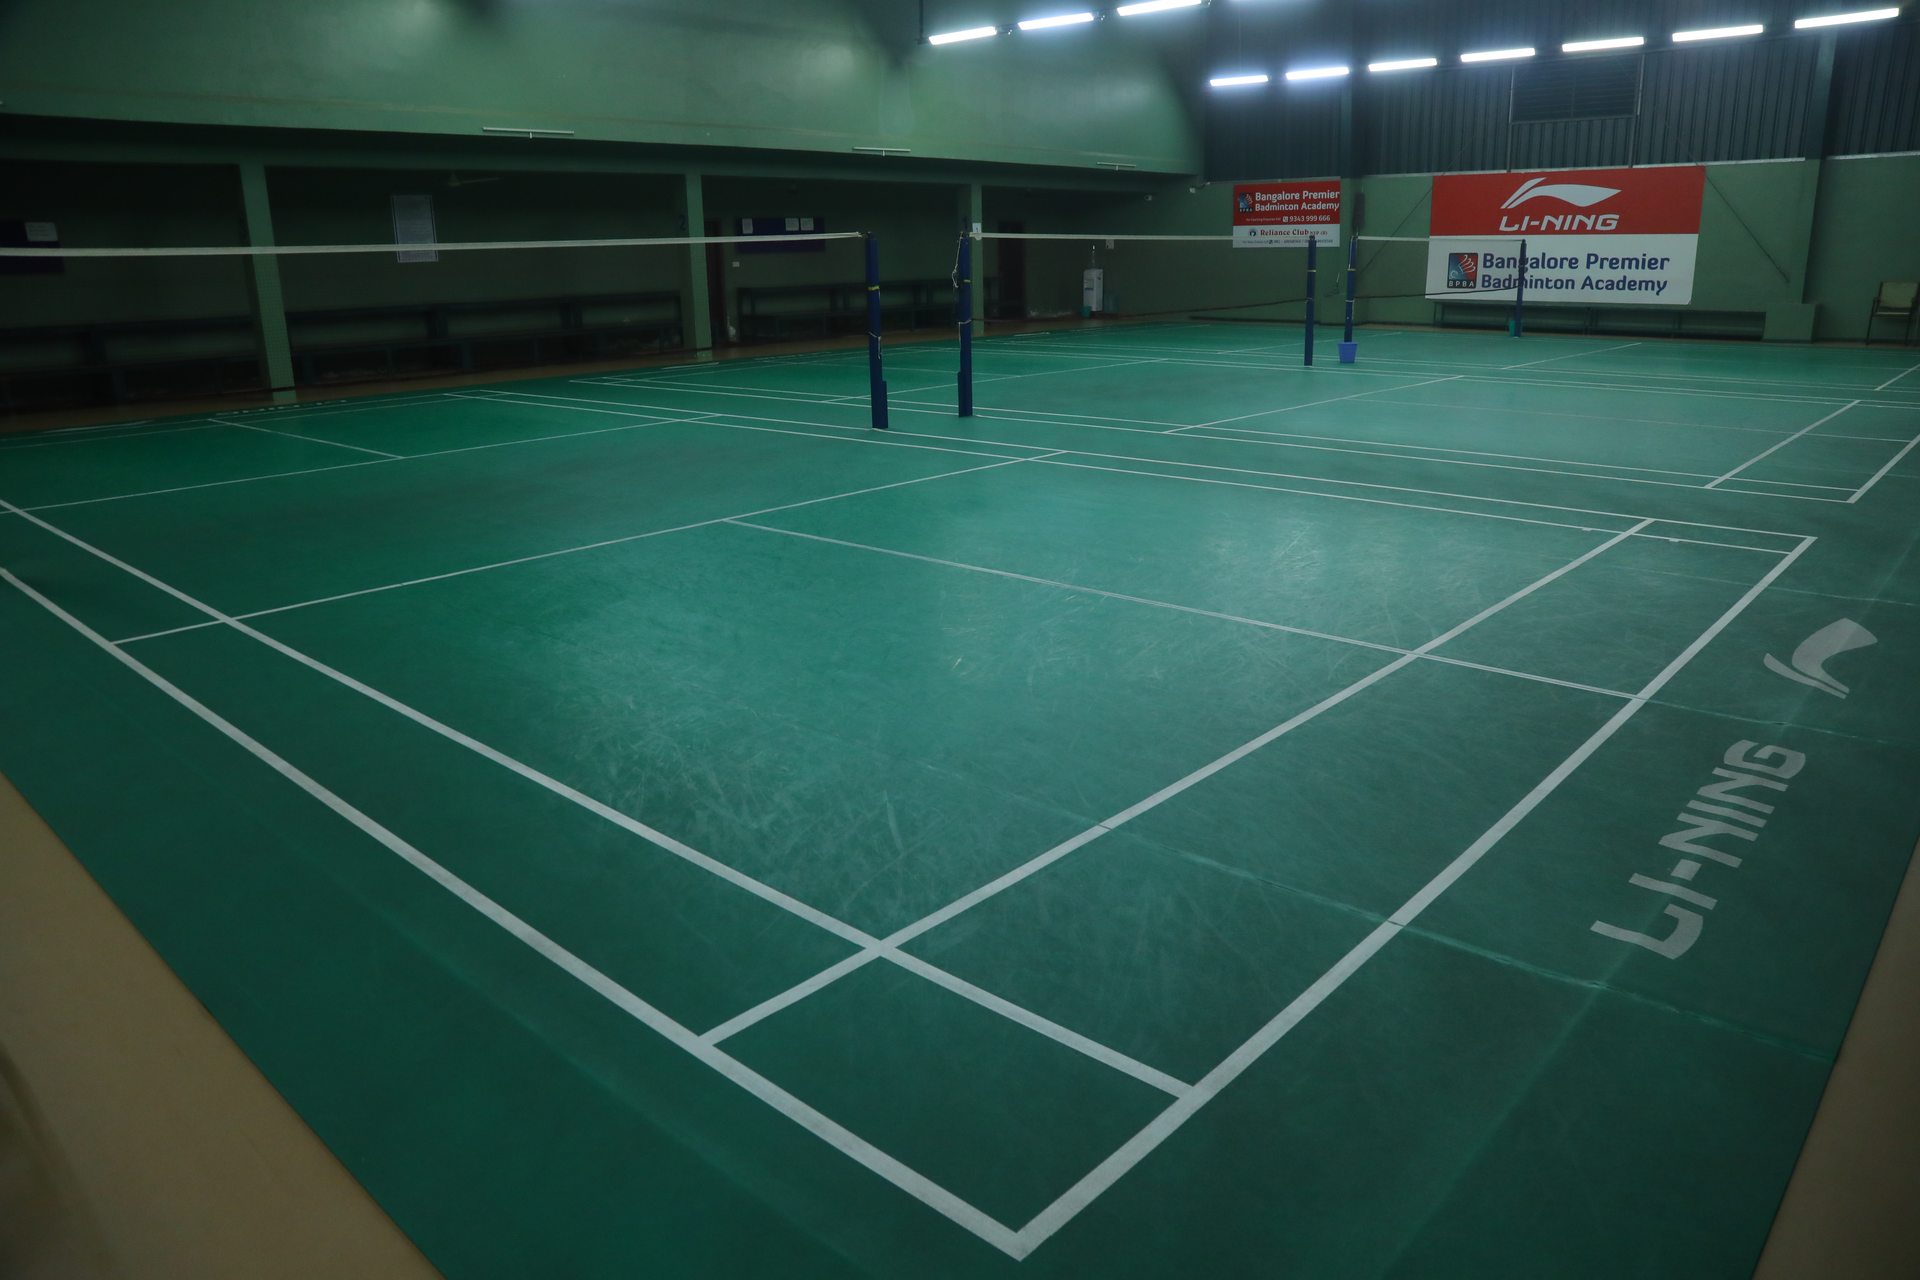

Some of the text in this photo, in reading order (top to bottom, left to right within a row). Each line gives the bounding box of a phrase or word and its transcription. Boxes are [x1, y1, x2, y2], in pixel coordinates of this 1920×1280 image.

[1255, 190, 1340, 203] Bangalore Premier
[1255, 203, 1299, 212] Badminton
[1301, 202, 1340, 212] Academy
[1499, 214, 1620, 231] LI-NING
[1586, 253, 1670, 270] Premier
[1580, 275, 1668, 296] Academy
[1589, 738, 1806, 960] LI-NING
